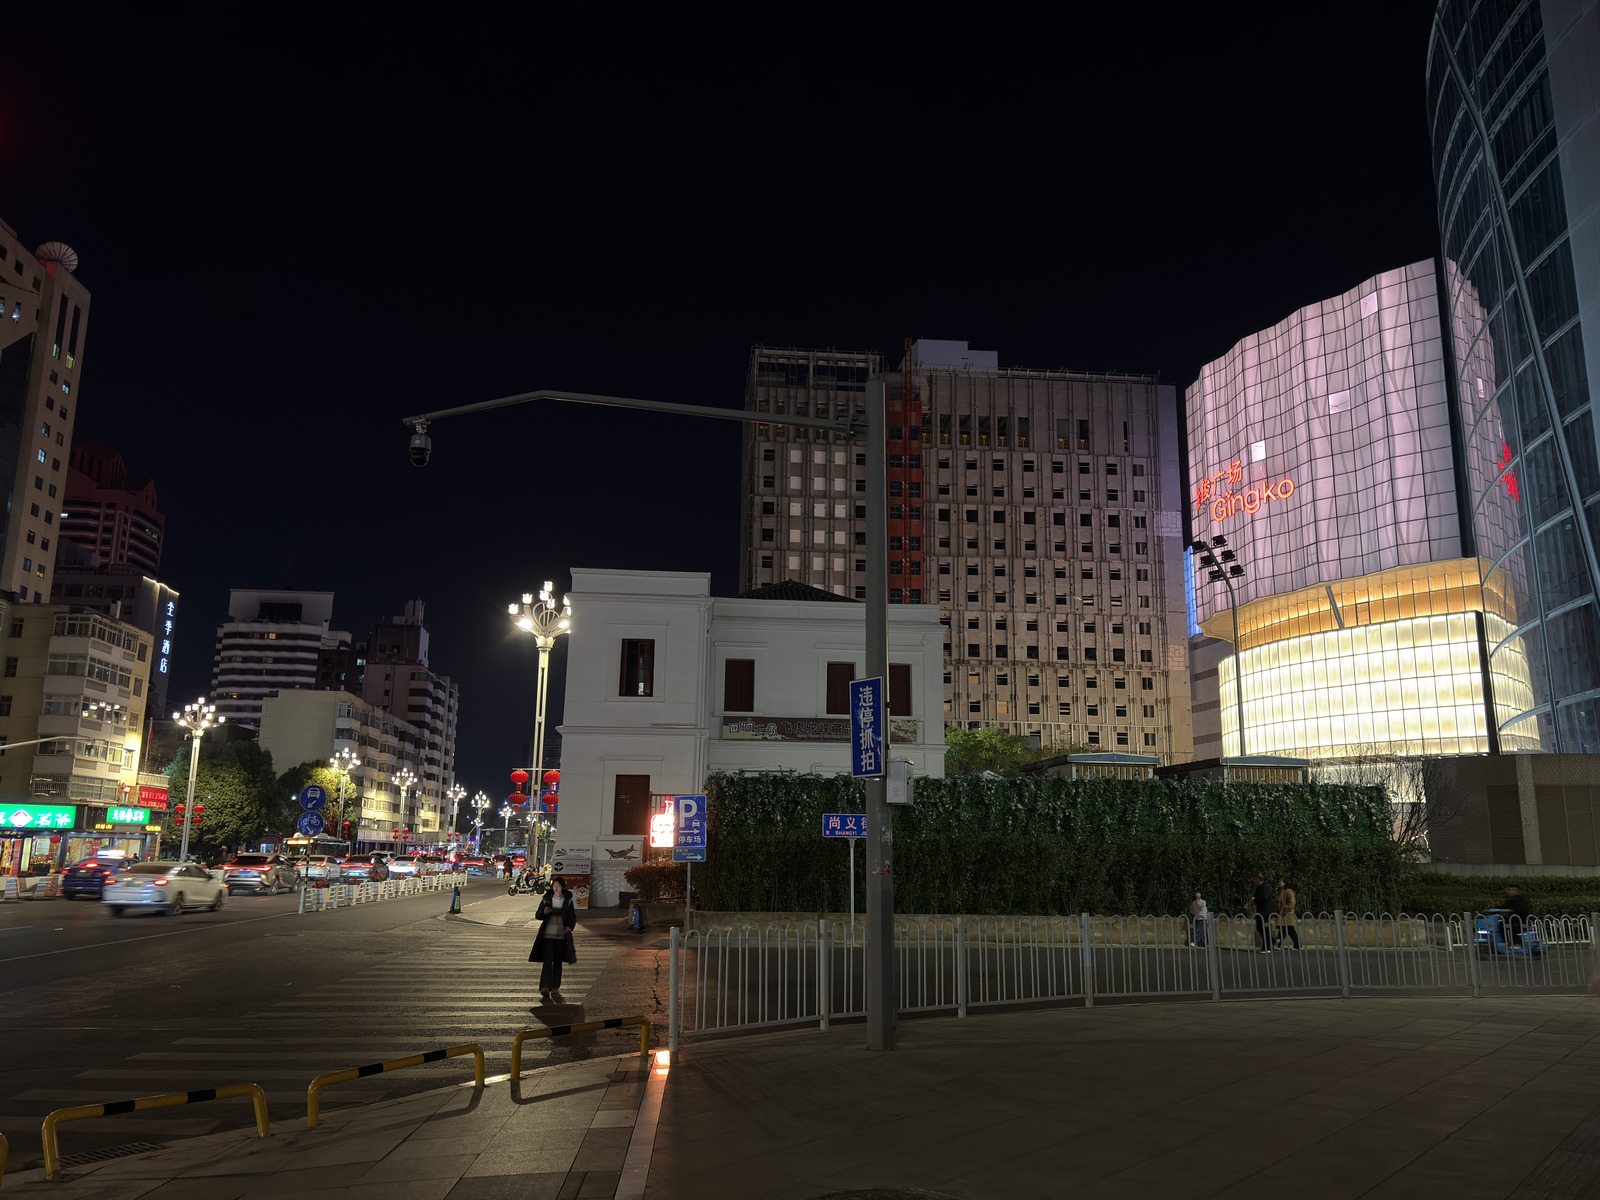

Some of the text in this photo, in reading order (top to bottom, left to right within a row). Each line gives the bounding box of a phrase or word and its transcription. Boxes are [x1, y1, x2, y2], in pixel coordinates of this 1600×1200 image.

[1212, 478, 1295, 522] Gingko
[159, 601, 175, 674] 全季酒店
[858, 685, 875, 773] 违停抓拍
[679, 799, 698, 828] P
[678, 835, 702, 844] 停车场
